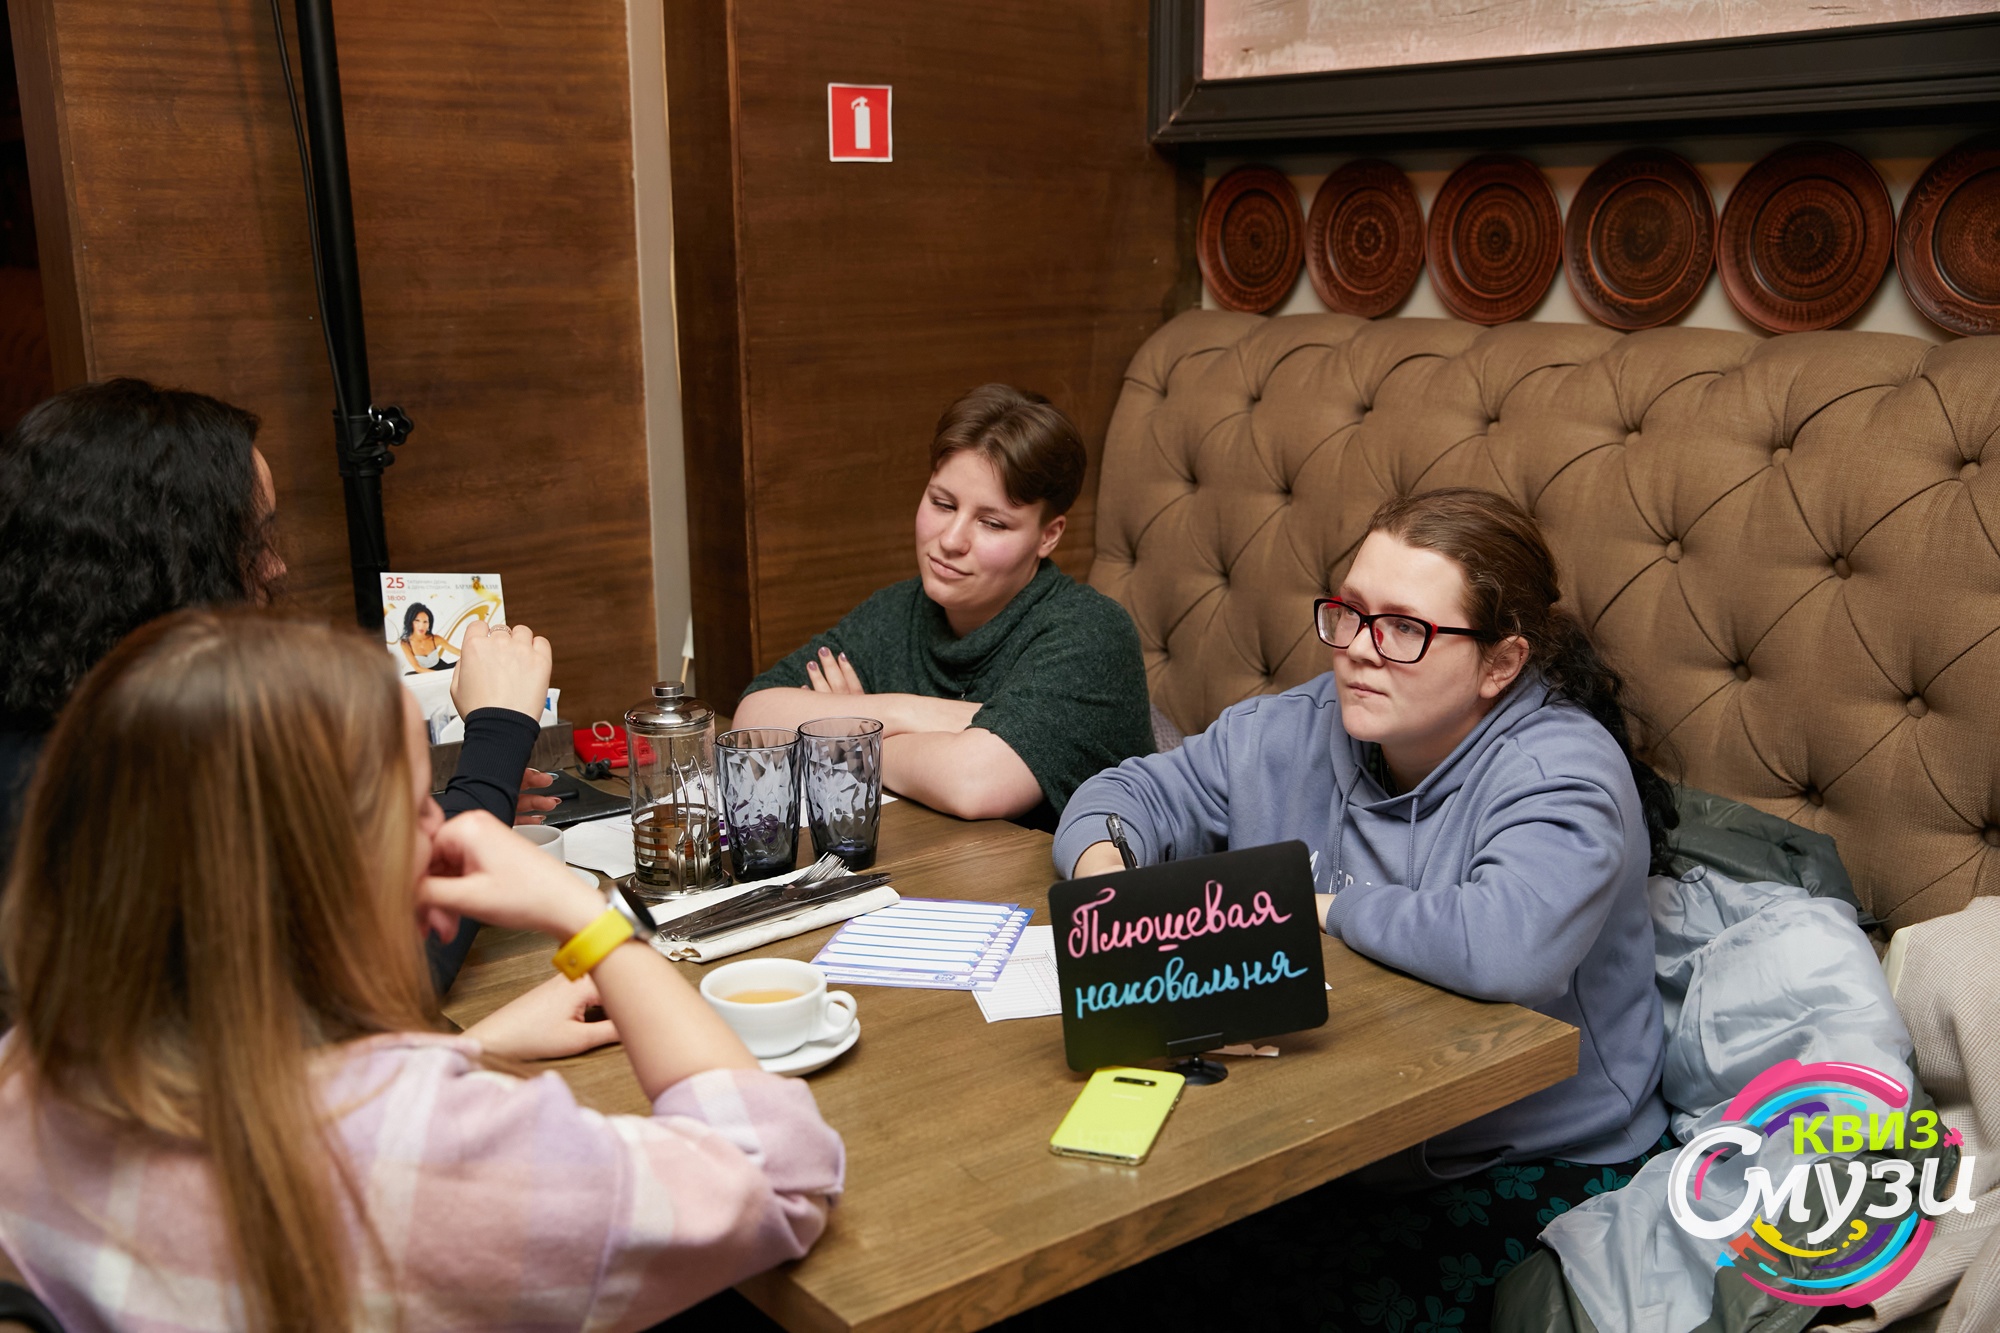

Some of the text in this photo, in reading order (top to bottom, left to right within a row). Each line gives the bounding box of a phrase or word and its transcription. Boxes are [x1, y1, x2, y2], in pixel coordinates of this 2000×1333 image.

[386, 576, 405, 589] 25
[1068, 880, 1292, 959] Плюшевая
[1075, 951, 1308, 1019] наковальня
